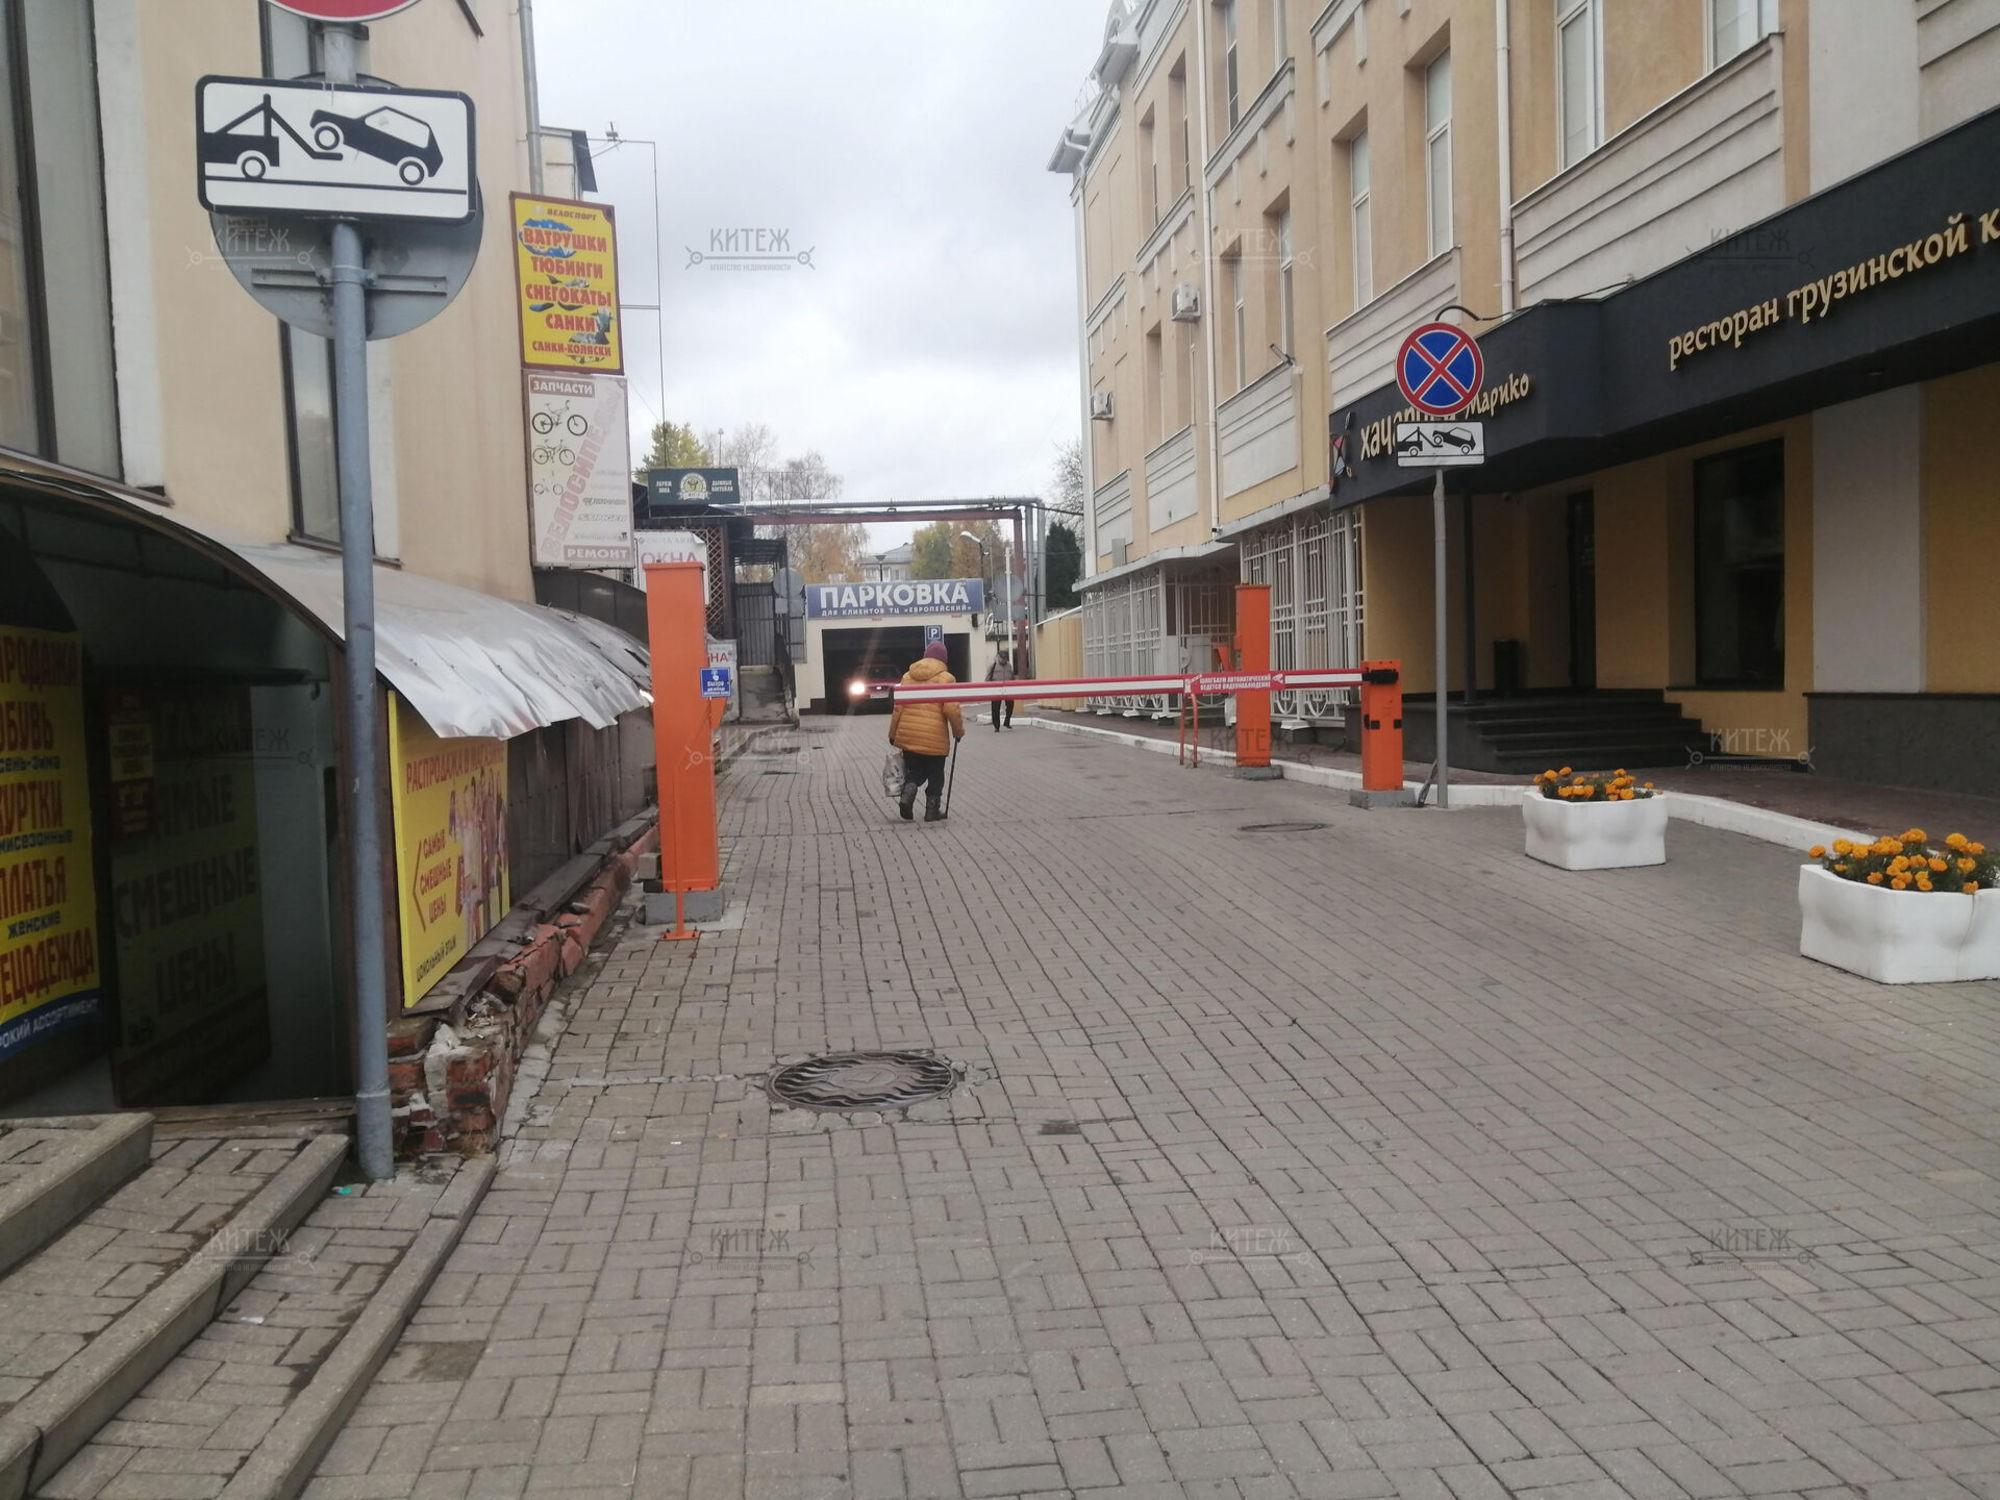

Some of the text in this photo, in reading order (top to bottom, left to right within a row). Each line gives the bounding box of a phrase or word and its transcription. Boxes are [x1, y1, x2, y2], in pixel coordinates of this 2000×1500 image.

[547, 208, 597, 221] ВЕЛОСПОРТ
[524, 227, 607, 252] ВАТРУШКИ
[531, 257, 603, 280] ТЮБИНГИ
[525, 284, 611, 307] СНЕГОКАТЫ
[1668, 298, 1780, 372] ресторан
[1786, 212, 1968, 324] грузинской
[545, 314, 595, 332] САНКИ
[532, 340, 611, 356] САНКИ-КОЛЯСКИ
[533, 380, 593, 394] ЗАПЧАСТИ
[567, 548, 628, 560] РЕМОНТ
[641, 552, 697, 562] ОКНА
[820, 582, 969, 608] ПАРКОВКА
[822, 609, 838, 617] ДЛЯ
[842, 607, 884, 616] КЛИЕНТОВ
[420, 858, 451, 895] СМЕШНЫЕ
[115, 846, 257, 940] СМЕШНЫЕ
[8, 911, 61, 939] женские
[33, 999, 99, 1033] АССОРТИМЕНТ
